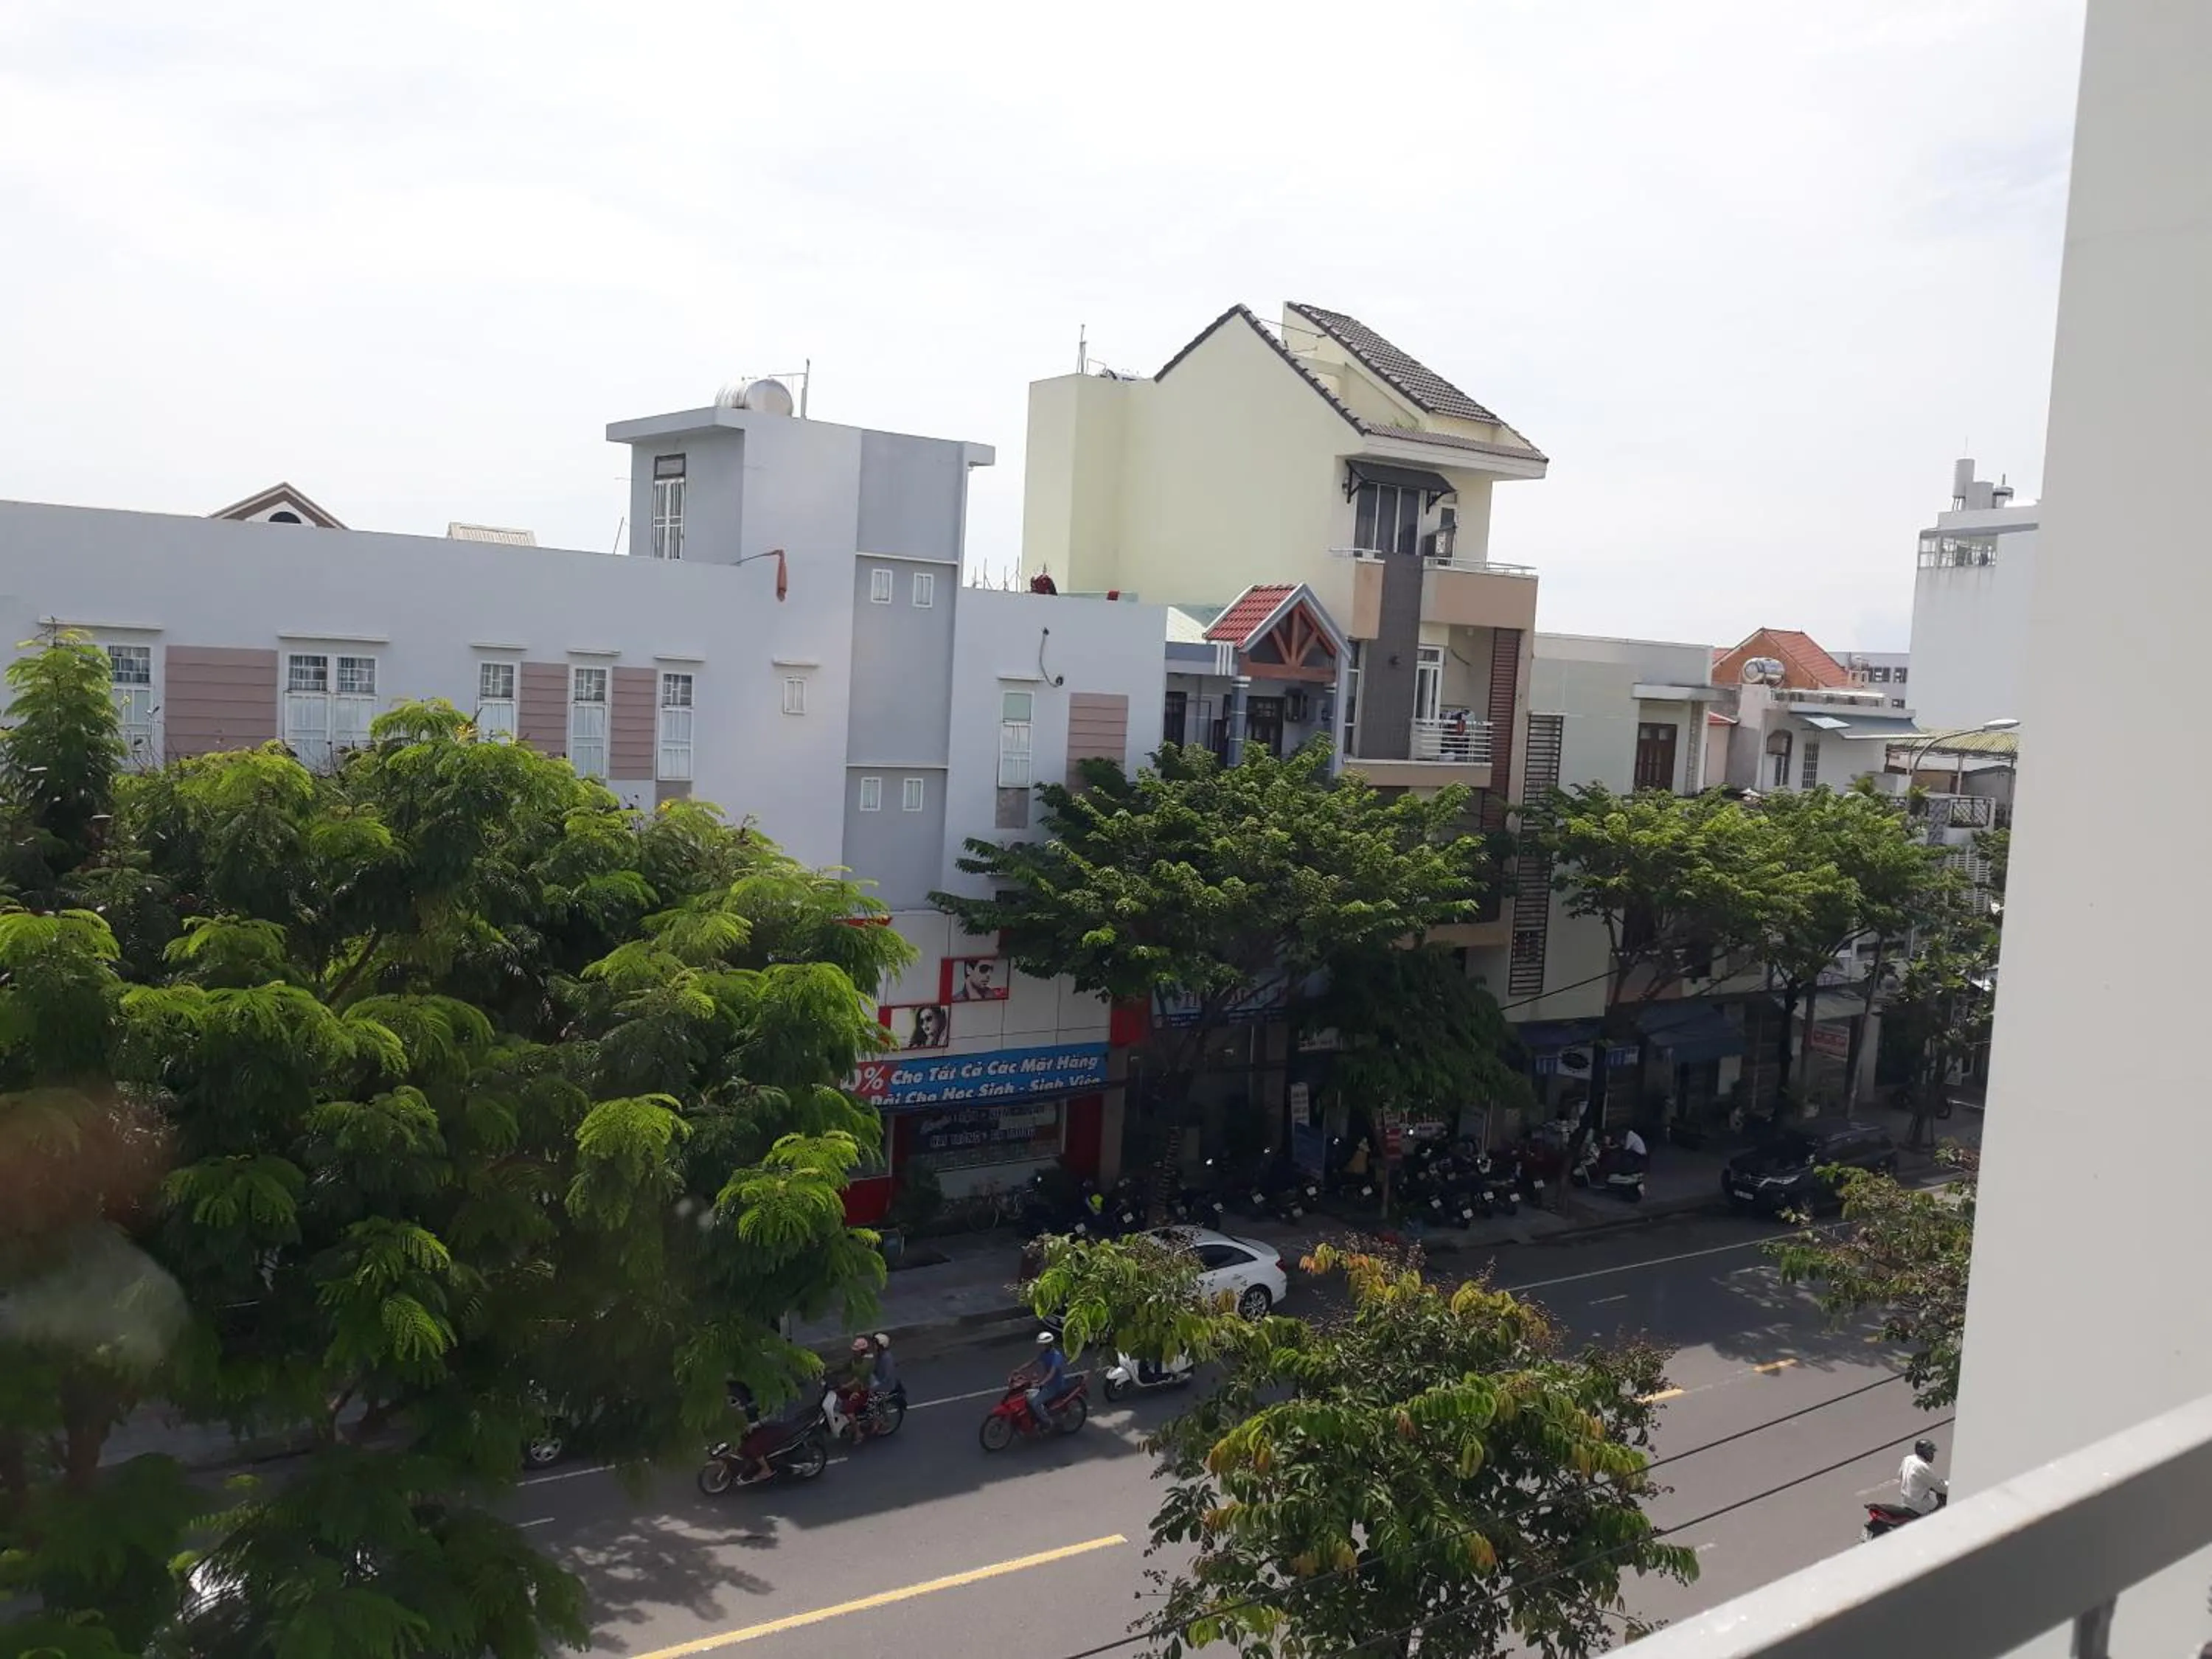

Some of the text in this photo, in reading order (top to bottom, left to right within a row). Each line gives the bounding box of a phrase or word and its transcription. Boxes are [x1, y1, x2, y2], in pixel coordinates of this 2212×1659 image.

[891, 1070, 923, 1085] Cho
[929, 1063, 956, 1082] Tất
[961, 1061, 983, 1078] Cả
[987, 1059, 1017, 1075] Các
[1020, 1057, 1053, 1075] Mặt
[1056, 1054, 1098, 1070] Hàng
[905, 1091, 937, 1104] Cho
[978, 1082, 1015, 1097] Sinh
[1029, 1077, 1064, 1091] Sinh
